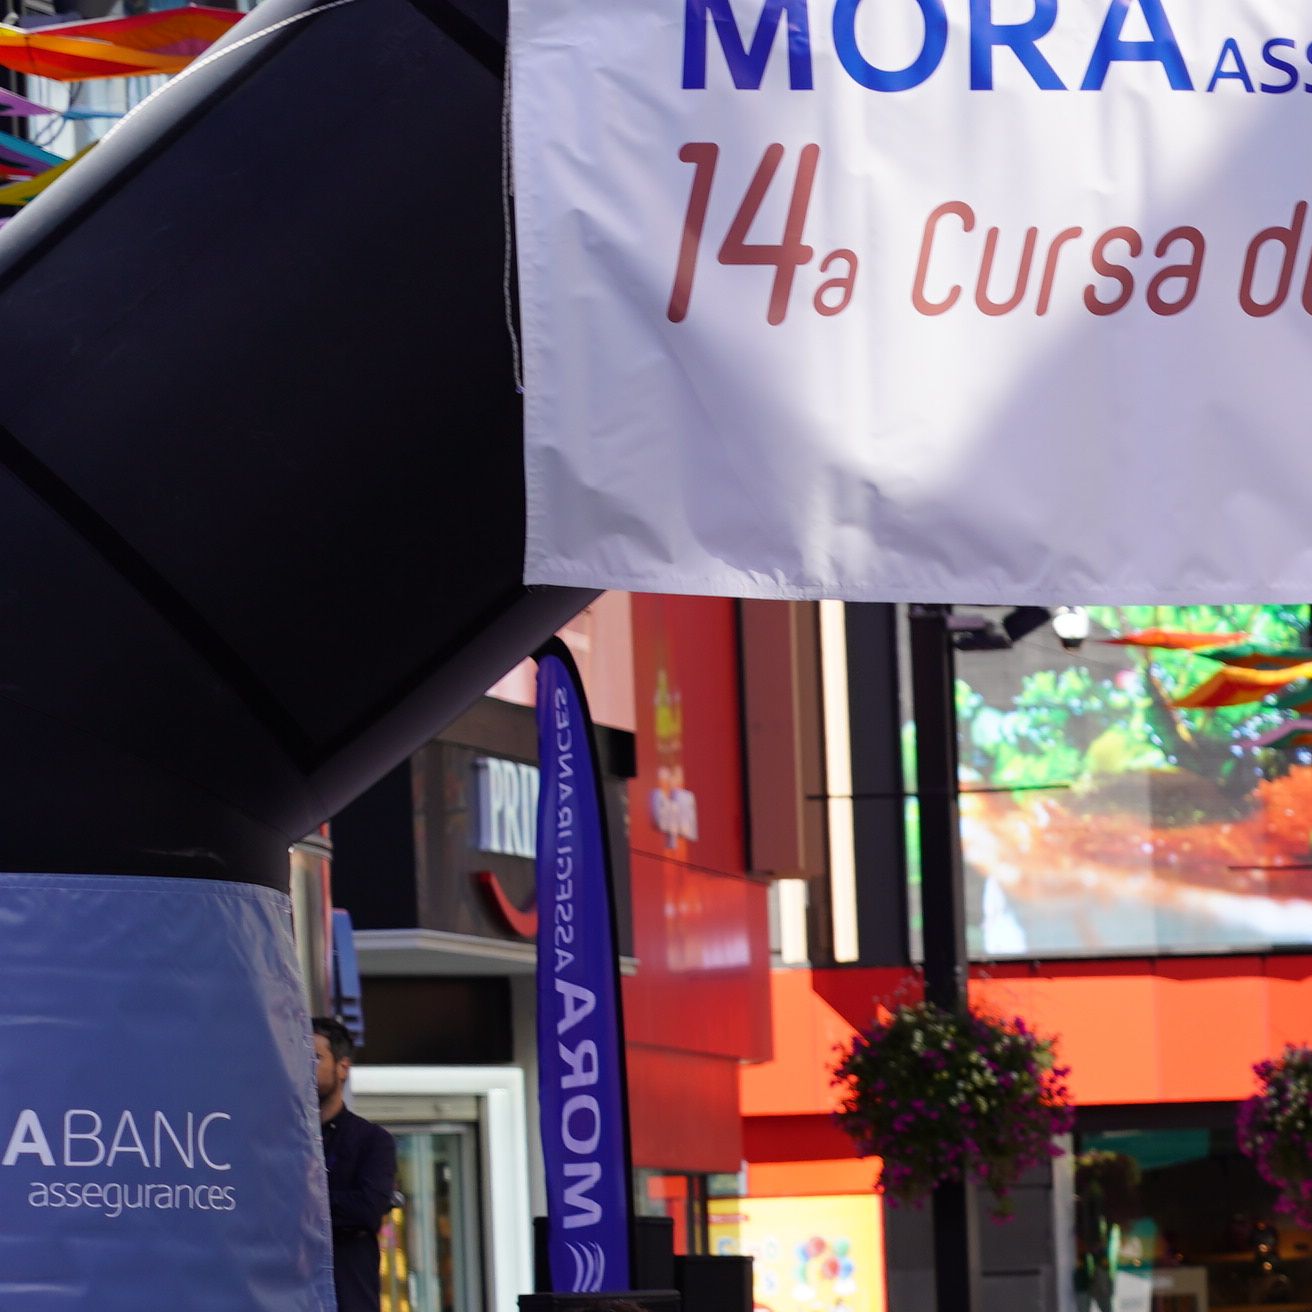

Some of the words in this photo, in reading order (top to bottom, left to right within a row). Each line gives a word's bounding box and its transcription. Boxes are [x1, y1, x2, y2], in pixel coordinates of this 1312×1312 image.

[680, 0, 1195, 92] MORA
[667, 141, 859, 326] 14a
[911, 199, 1205, 318] Cursa
[27, 1182, 236, 1218] assegurances
